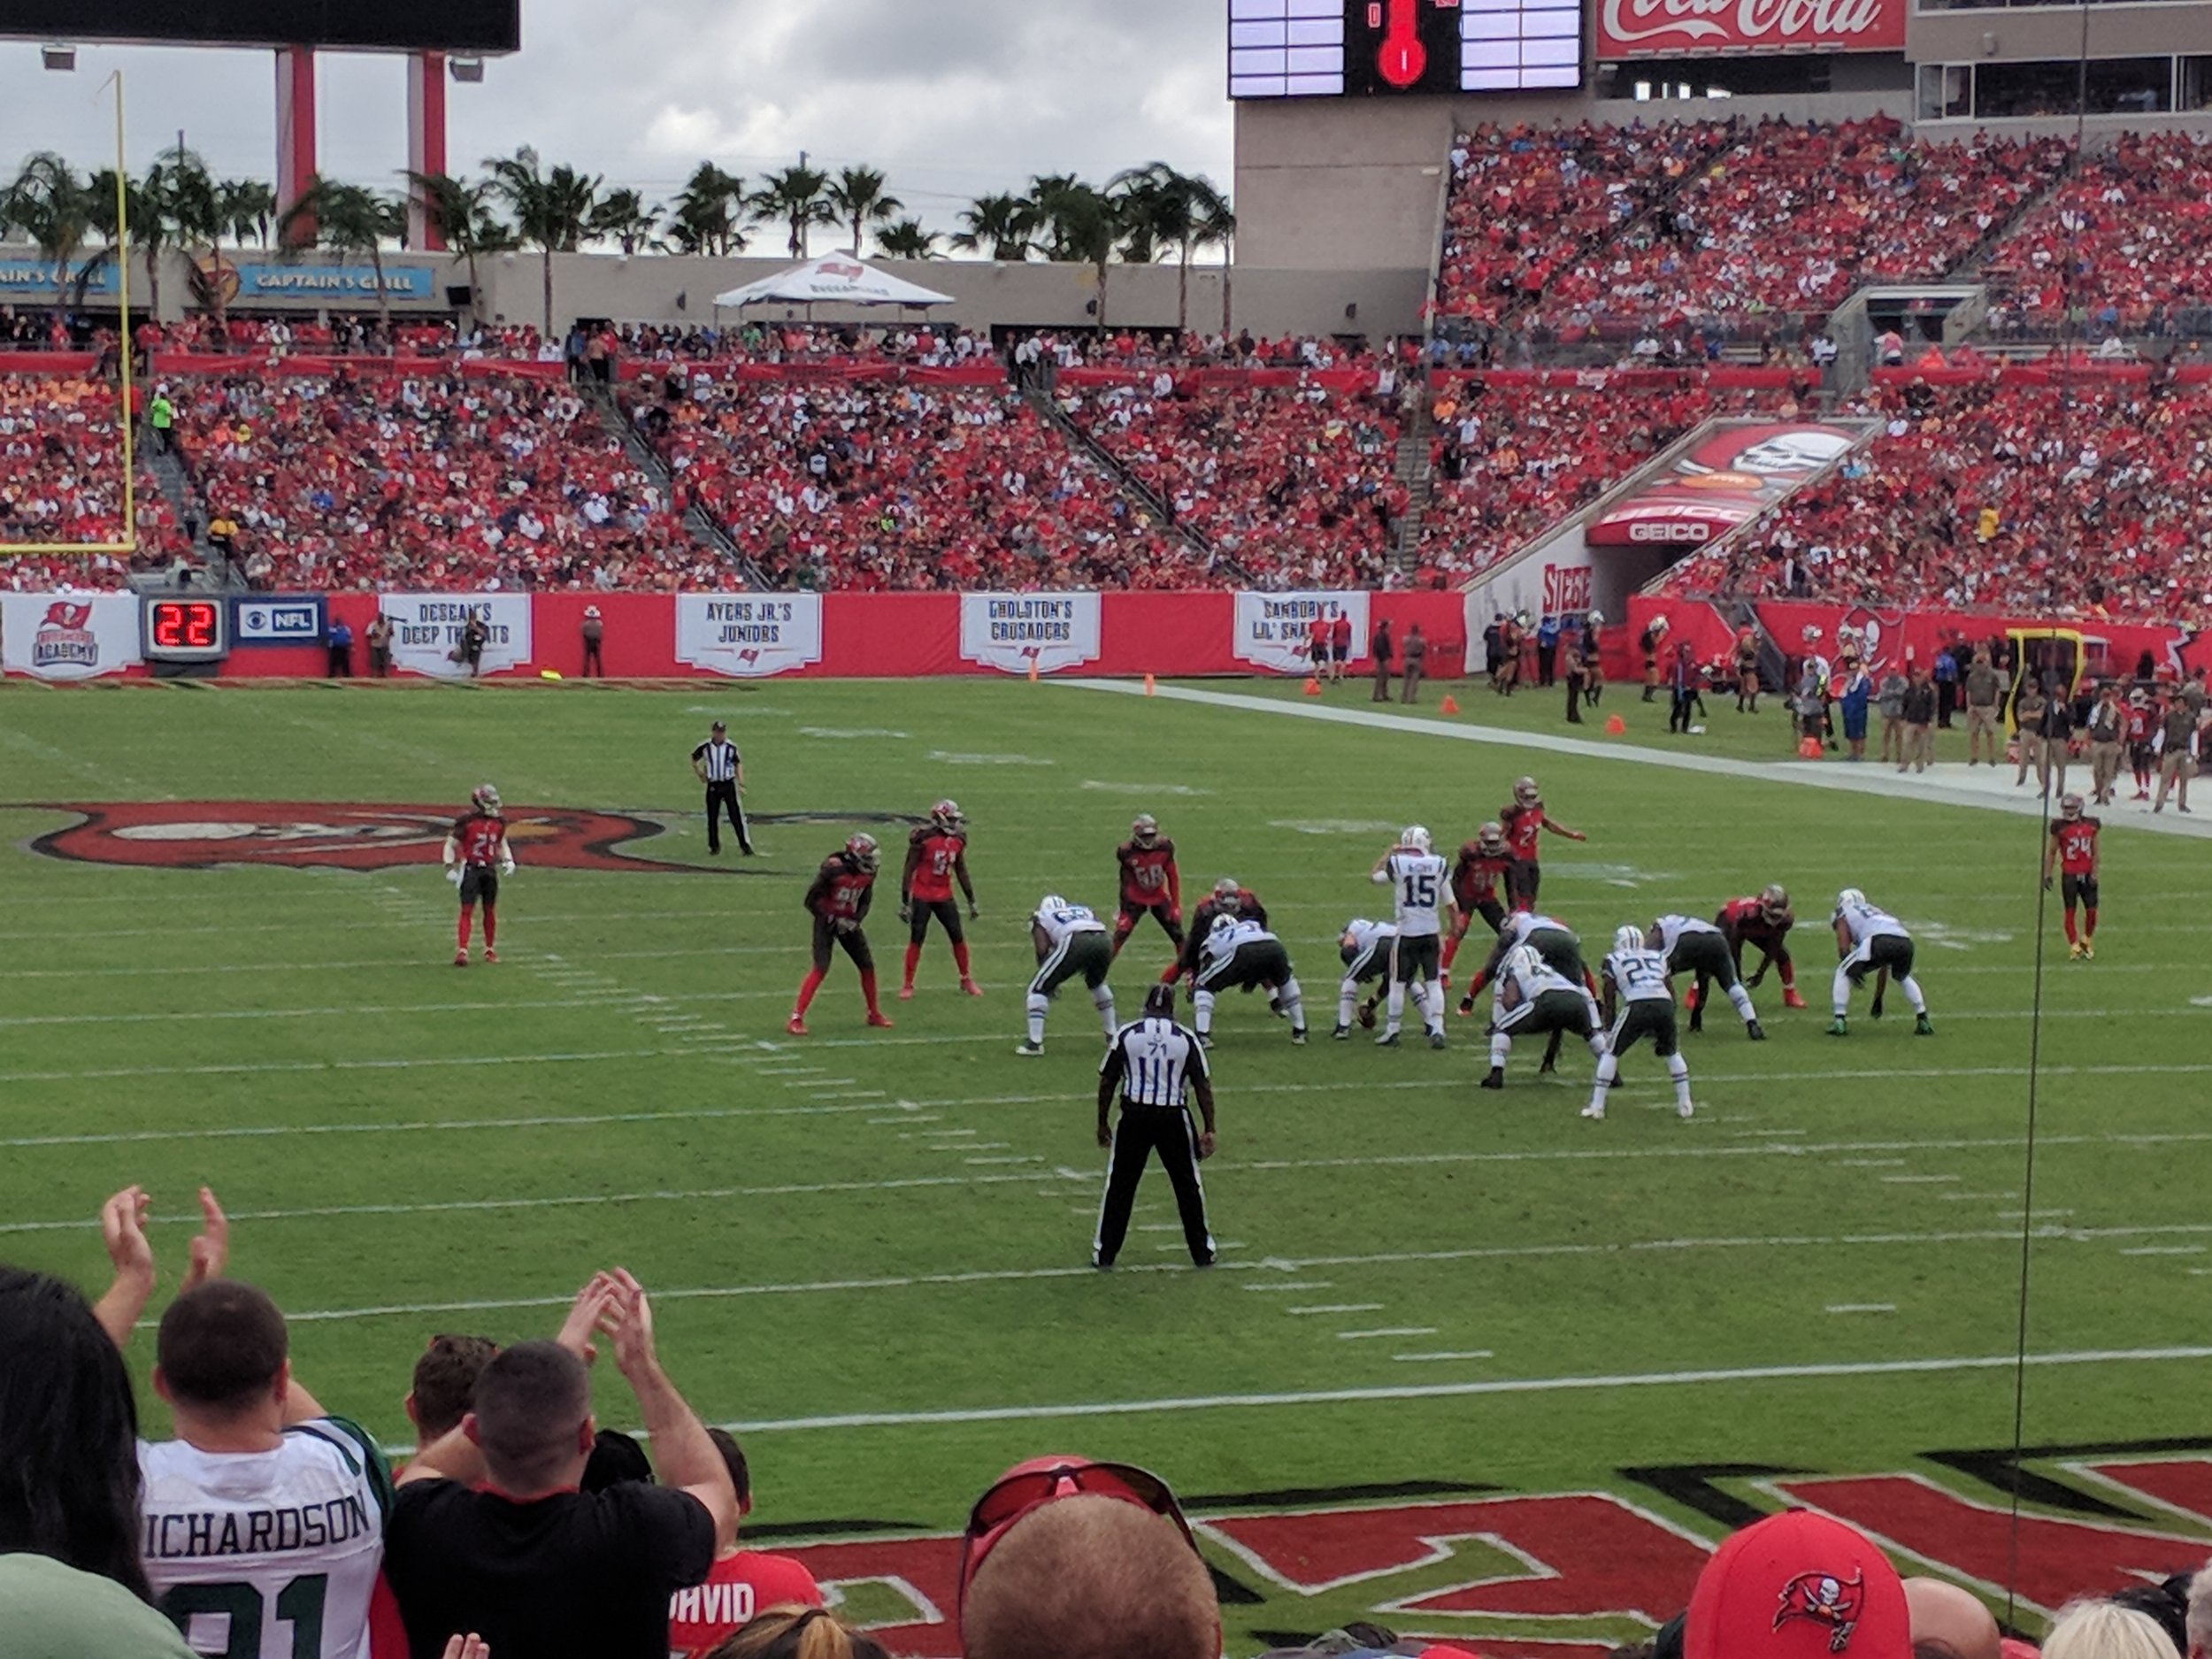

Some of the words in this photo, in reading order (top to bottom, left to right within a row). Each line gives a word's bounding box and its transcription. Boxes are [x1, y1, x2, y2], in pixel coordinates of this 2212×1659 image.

[257, 274, 354, 289] CAPTAIN'S
[1629, 522, 1709, 541] GEICO
[275, 611, 311, 628] NFL
[707, 602, 753, 621] AYERS
[157, 605, 213, 644] 22
[718, 625, 780, 642] JUNIORS
[991, 622, 1071, 640] CRUSADERS
[402, 625, 440, 644] DEEP
[1402, 875, 1438, 908] 15
[1621, 956, 1663, 987] 25
[1147, 1042, 1168, 1056] 71
[145, 1488, 370, 1559] ICHARDSON
